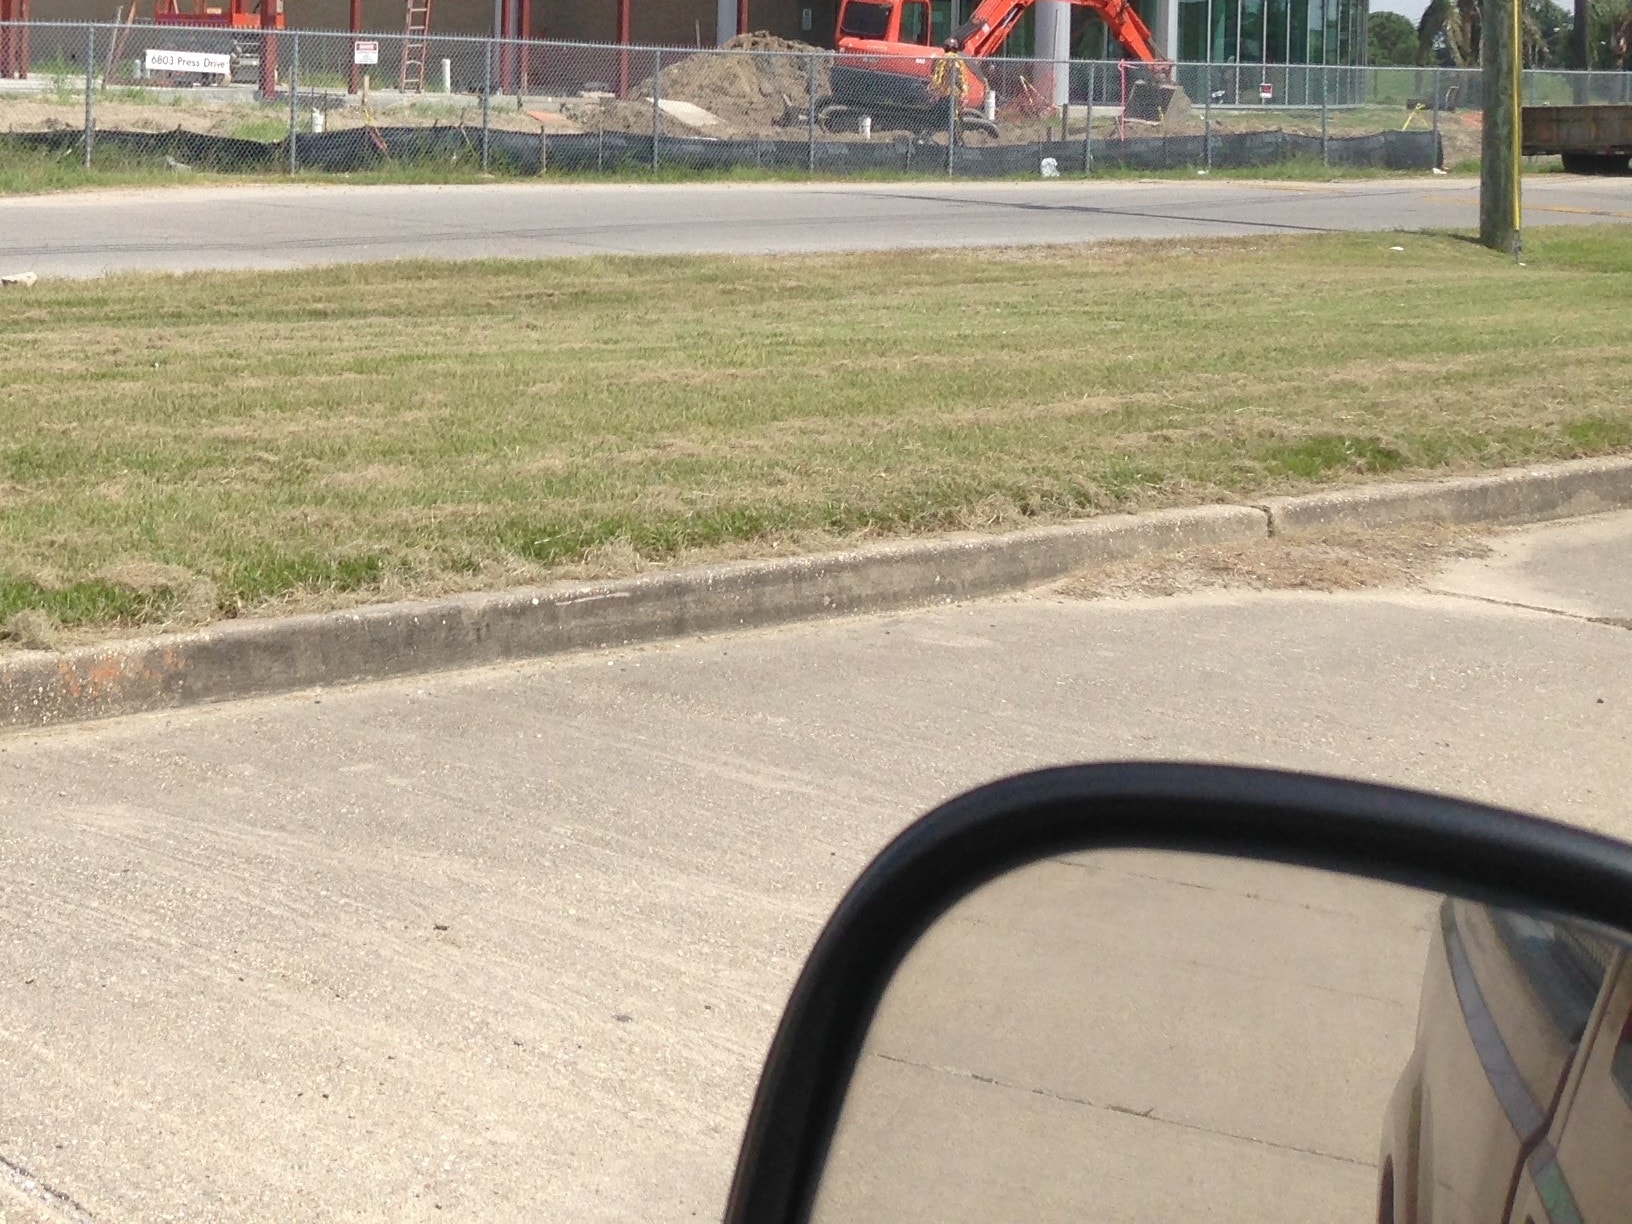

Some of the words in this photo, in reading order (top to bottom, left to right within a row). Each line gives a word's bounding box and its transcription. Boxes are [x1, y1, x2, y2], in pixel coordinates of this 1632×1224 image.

[151, 55, 174, 65] 6803
[177, 56, 200, 67] Press
[203, 57, 225, 68] Drive
